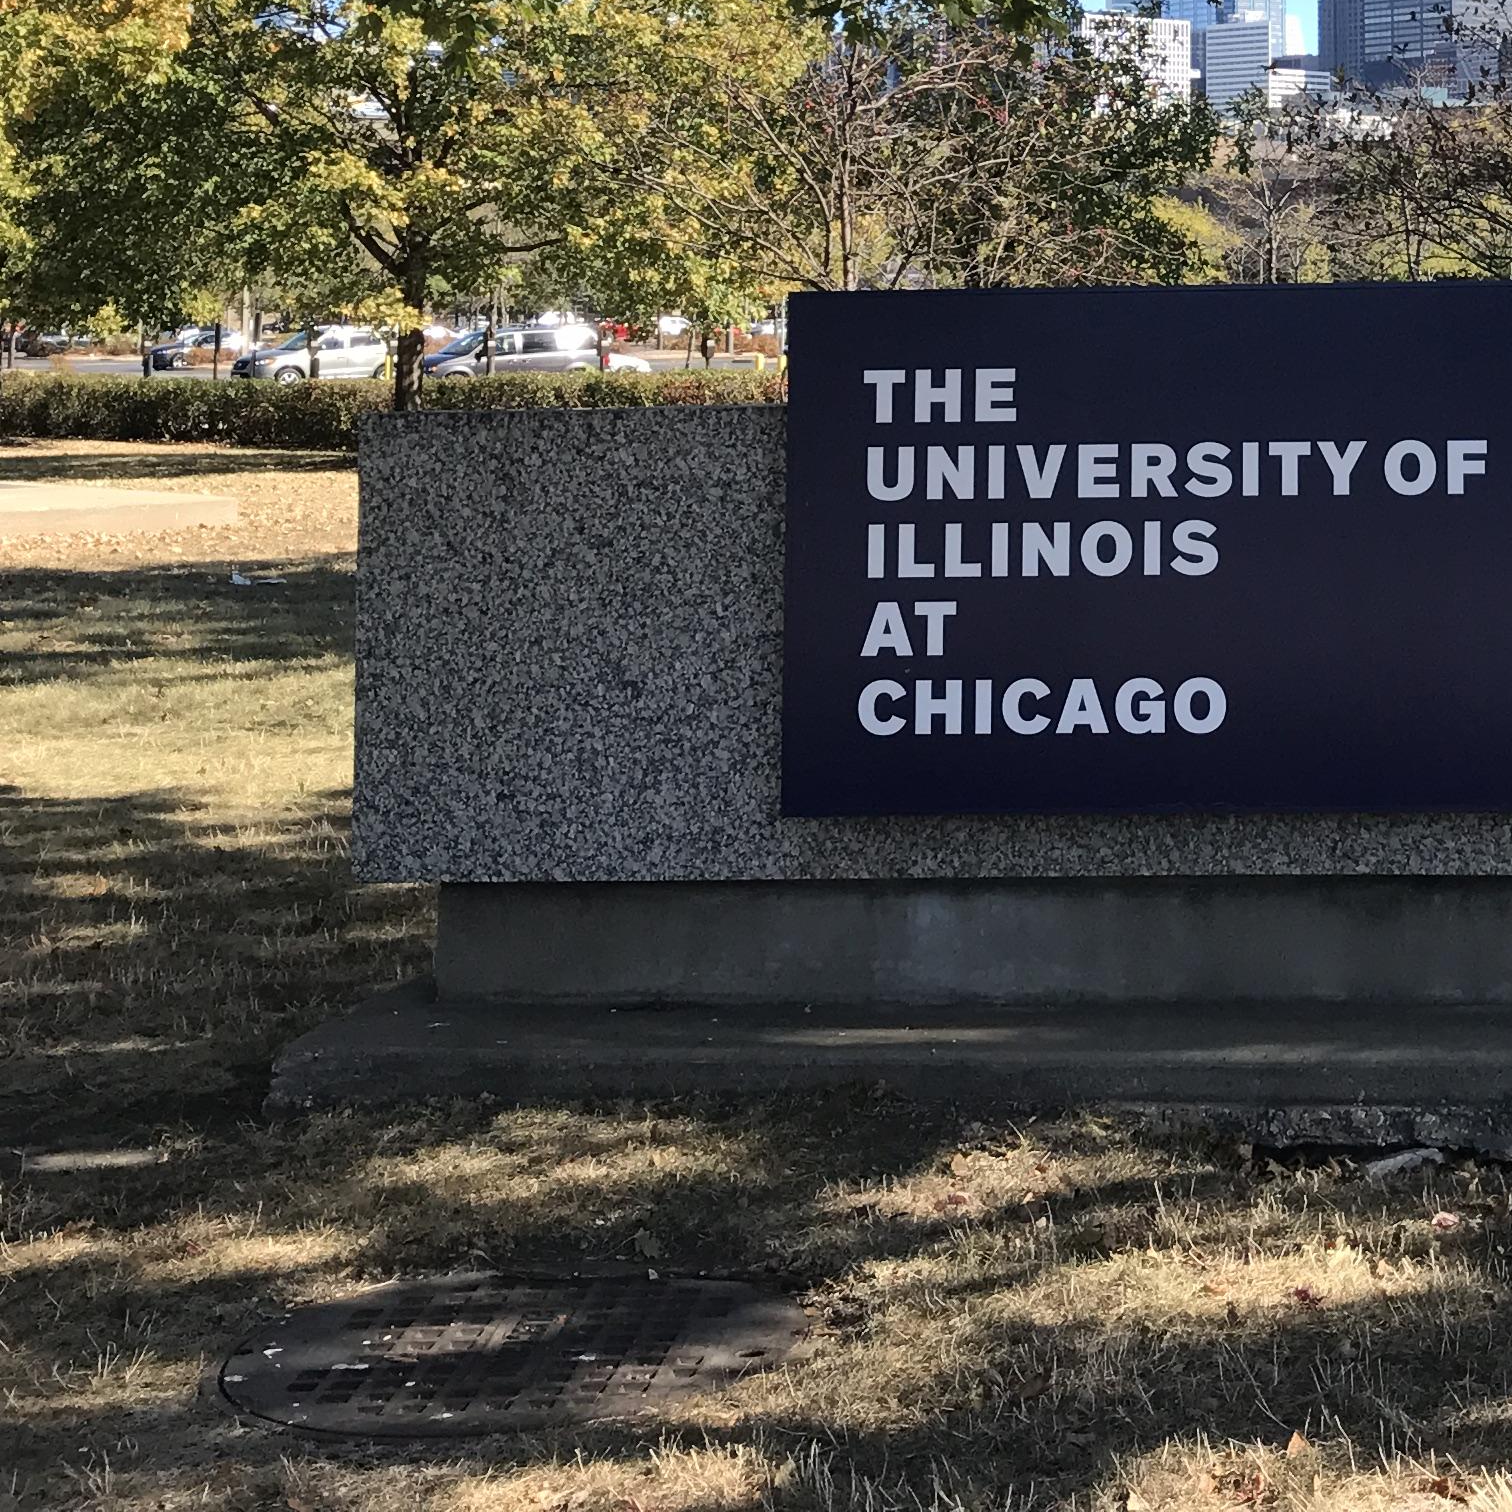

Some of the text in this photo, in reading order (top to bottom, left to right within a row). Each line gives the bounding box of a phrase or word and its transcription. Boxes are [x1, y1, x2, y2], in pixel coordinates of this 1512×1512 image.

[863, 367, 1017, 424] THE
[866, 439, 1488, 502] UNIVERSITY OF
[867, 519, 1219, 579] ILLINOIS
[860, 601, 957, 657] AT
[857, 676, 1227, 736] CHICAGO
